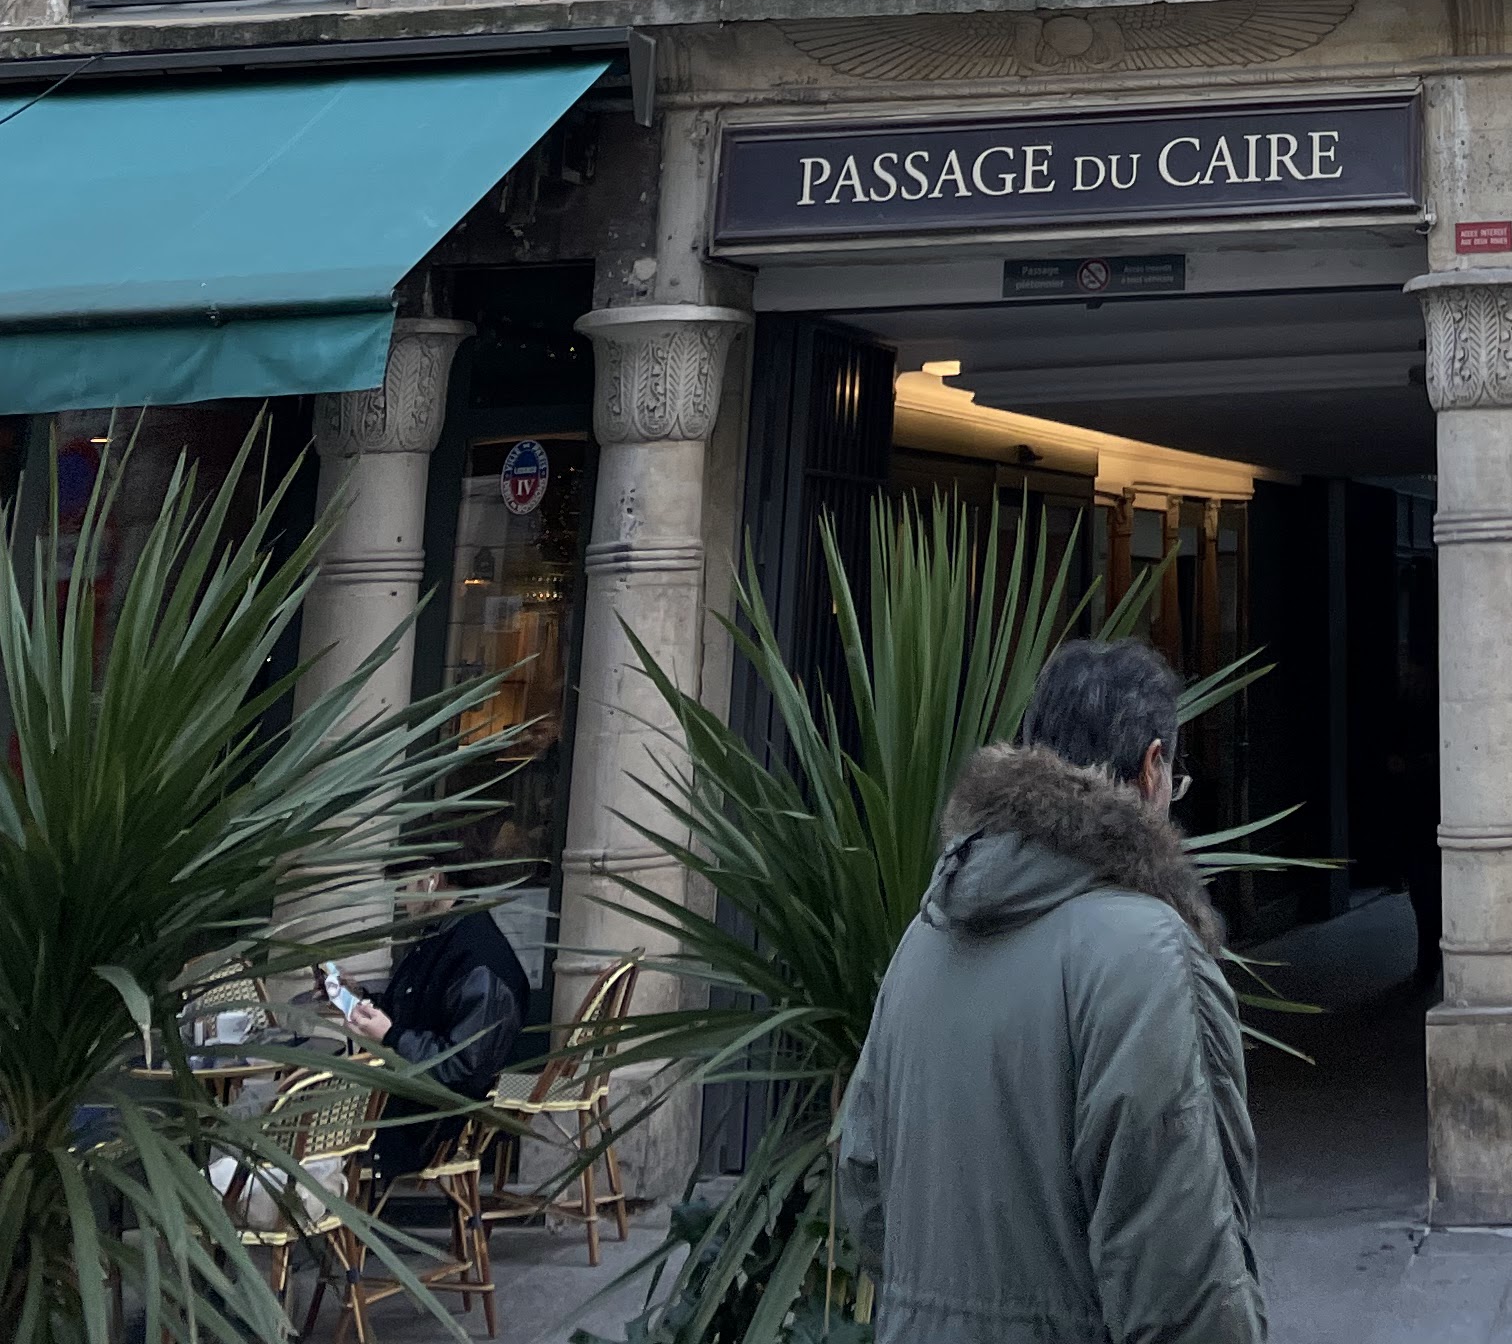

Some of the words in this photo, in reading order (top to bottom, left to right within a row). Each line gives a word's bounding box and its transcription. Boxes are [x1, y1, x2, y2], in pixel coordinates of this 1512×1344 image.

[797, 145, 1056, 206] PASSAGE
[1073, 154, 1141, 191] DU
[1159, 131, 1343, 187] CAIRE
[517, 479, 536, 496] IV
